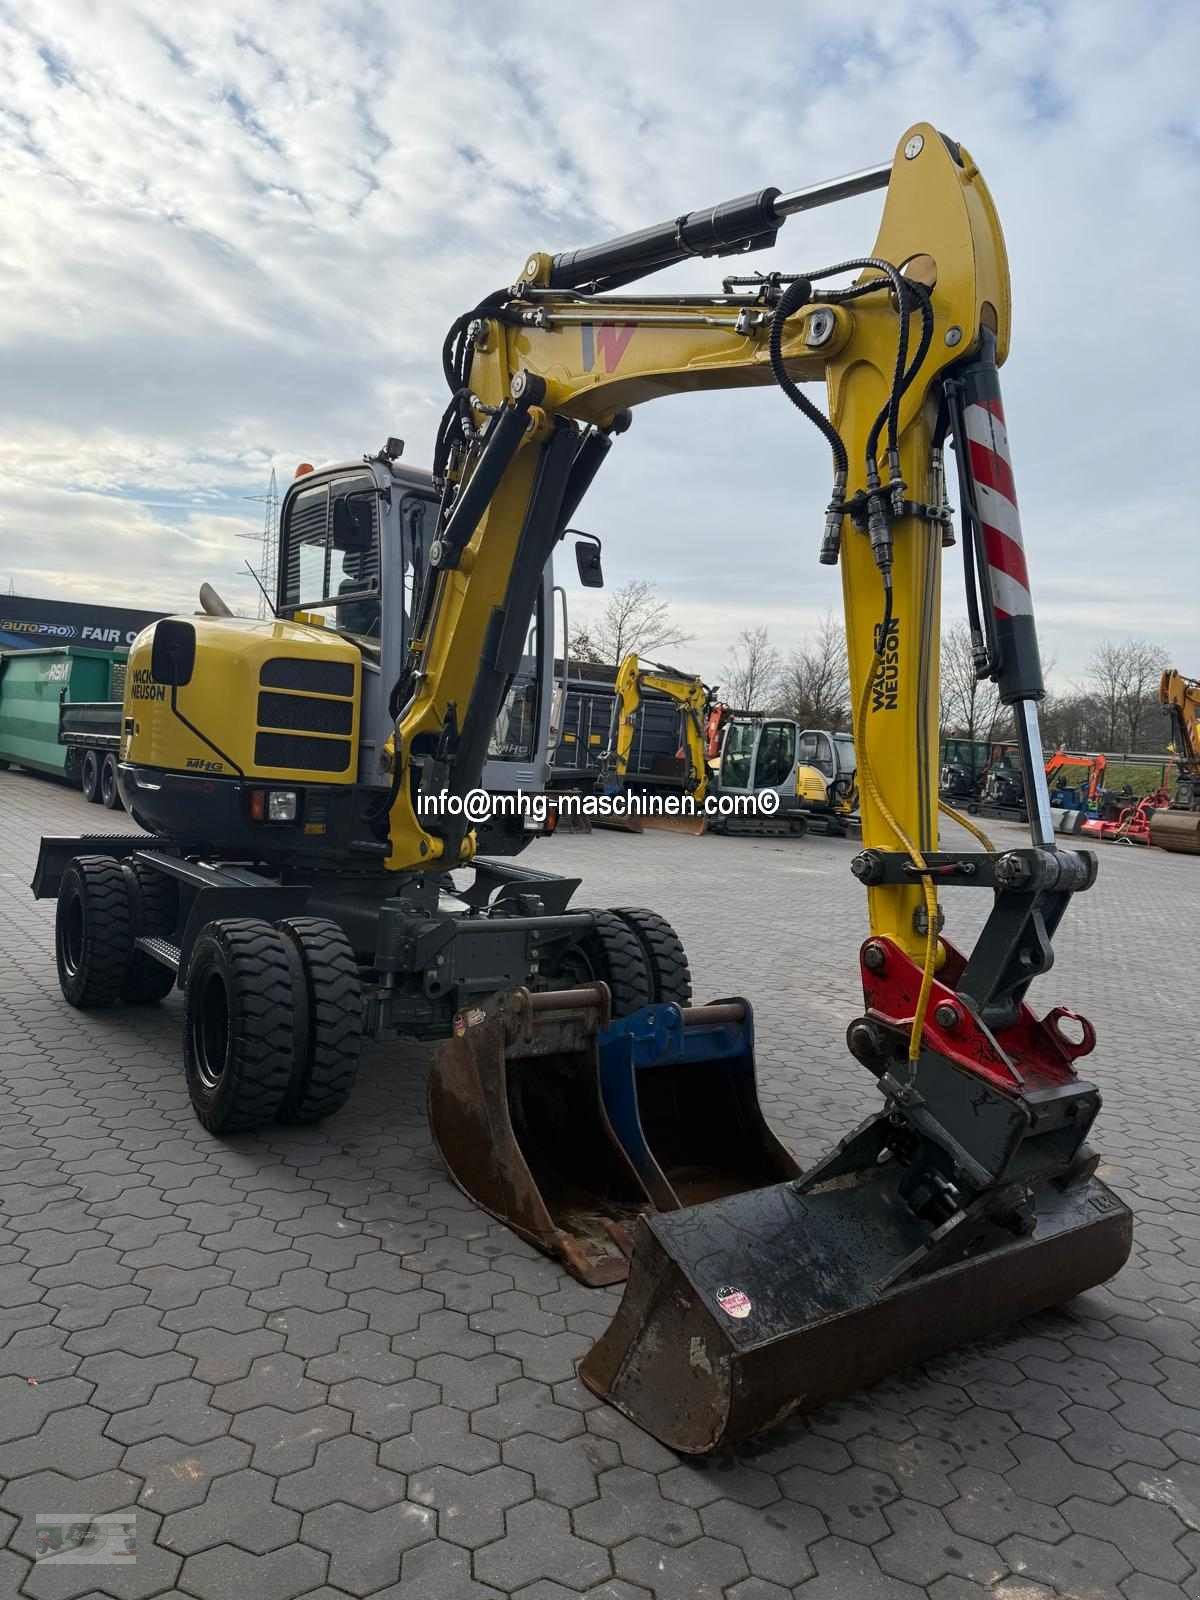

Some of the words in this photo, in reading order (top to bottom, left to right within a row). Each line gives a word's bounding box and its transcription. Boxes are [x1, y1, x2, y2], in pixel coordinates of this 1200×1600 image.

[81, 626, 121, 643] FAIR
[884, 618, 899, 710] NEUSON
[131, 684, 166, 700] NEUSON
